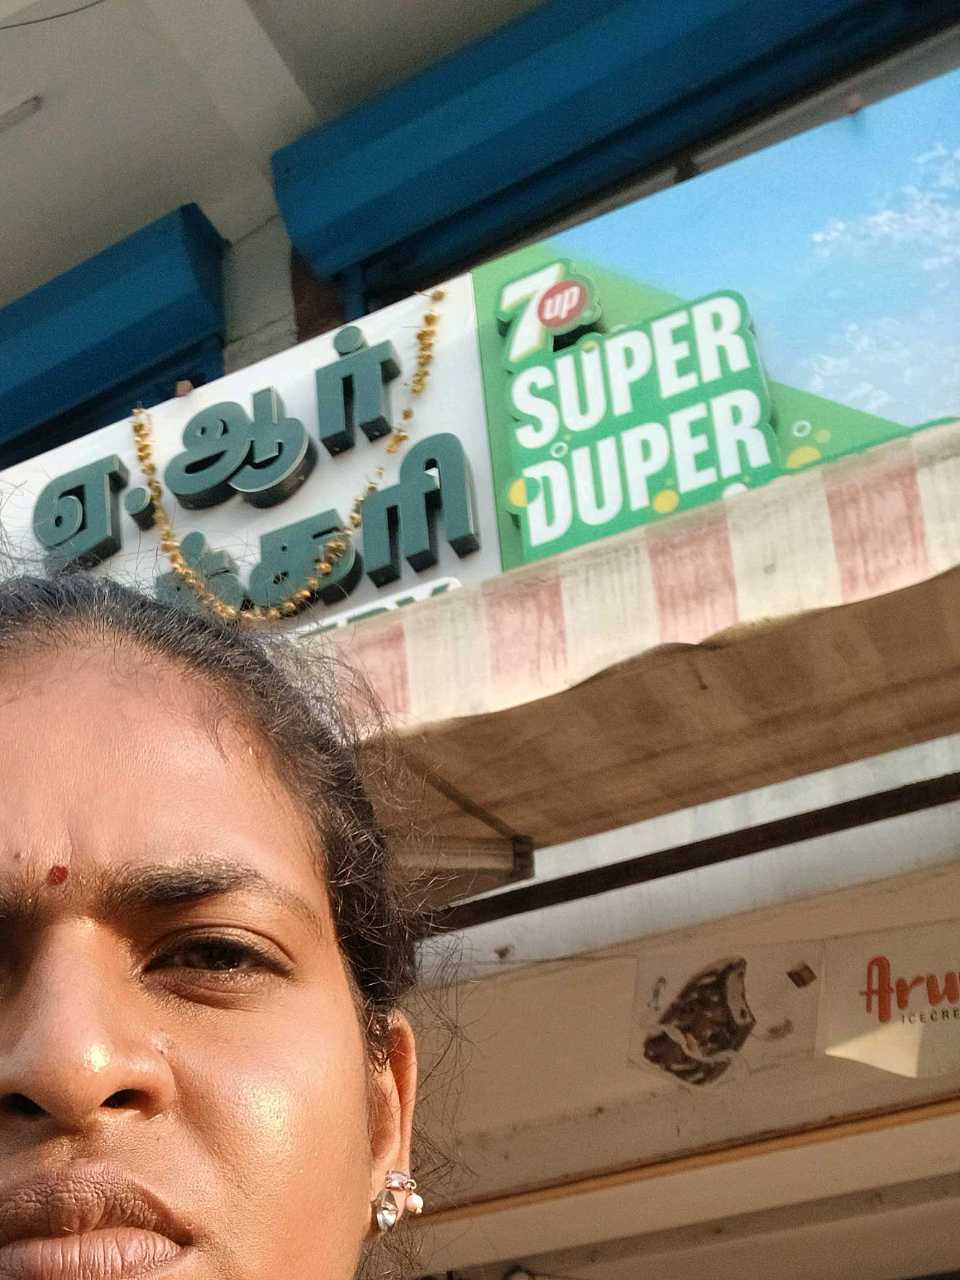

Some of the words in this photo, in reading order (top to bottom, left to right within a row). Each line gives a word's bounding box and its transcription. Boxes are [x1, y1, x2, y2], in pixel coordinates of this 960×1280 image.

[512, 296, 751, 450] SUPER
[522, 389, 771, 547] DUPER
[859, 956, 960, 1023] Aru
